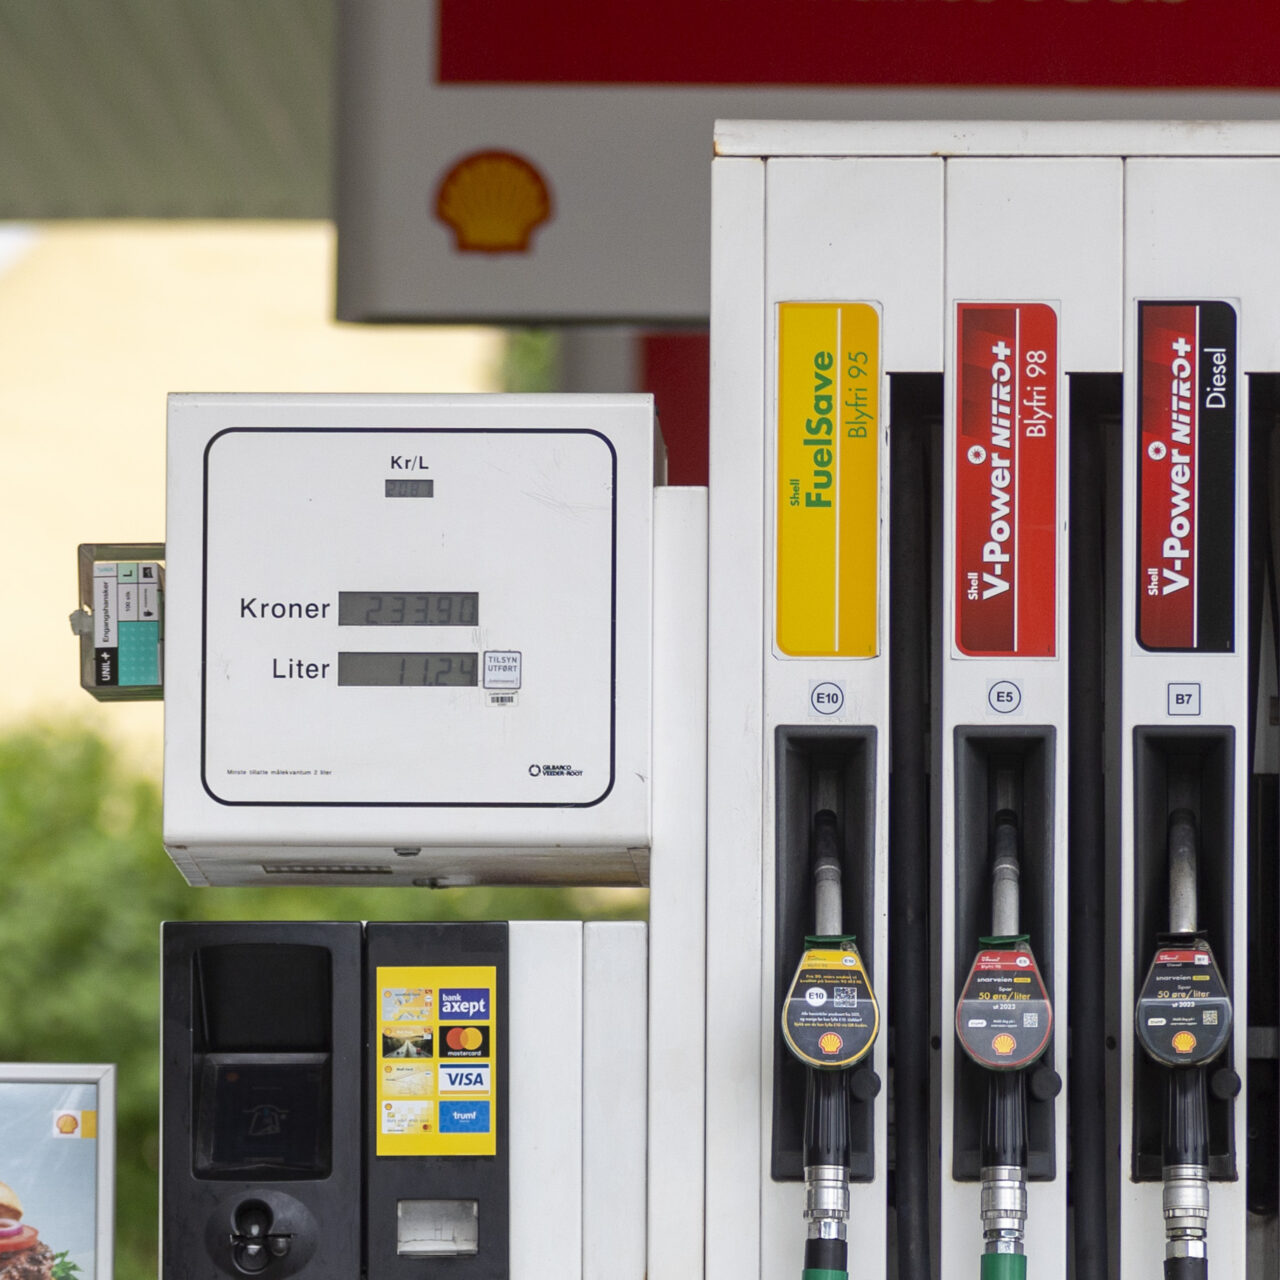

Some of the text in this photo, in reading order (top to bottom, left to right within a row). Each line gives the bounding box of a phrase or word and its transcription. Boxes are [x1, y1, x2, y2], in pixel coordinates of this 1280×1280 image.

[1203, 348, 1227, 408] Diesel
[845, 351, 874, 438] Blyfri 95
[1023, 350, 1053, 438] Blyfri 98
[803, 351, 834, 508] FuelSave
[391, 456, 429, 471] Kr/L
[790, 479, 800, 506] Shell
[982, 452, 1011, 600] V-Power
[1162, 448, 1191, 595] V-Power
[968, 572, 978, 600] Shell
[1148, 568, 1158, 595] Shell
[102, 582, 111, 643] Engangshansker
[241, 598, 330, 618] Kroner
[273, 658, 330, 678] Liter
[816, 692, 839, 704] E10
[996, 692, 1013, 702] E5
[1175, 694, 1193, 704] B7
[809, 992, 824, 1000] E10
[979, 992, 990, 1000] 50
[442, 998, 486, 1017] axept
[445, 1073, 484, 1086] VISA
[452, 1111, 477, 1120] trumf
